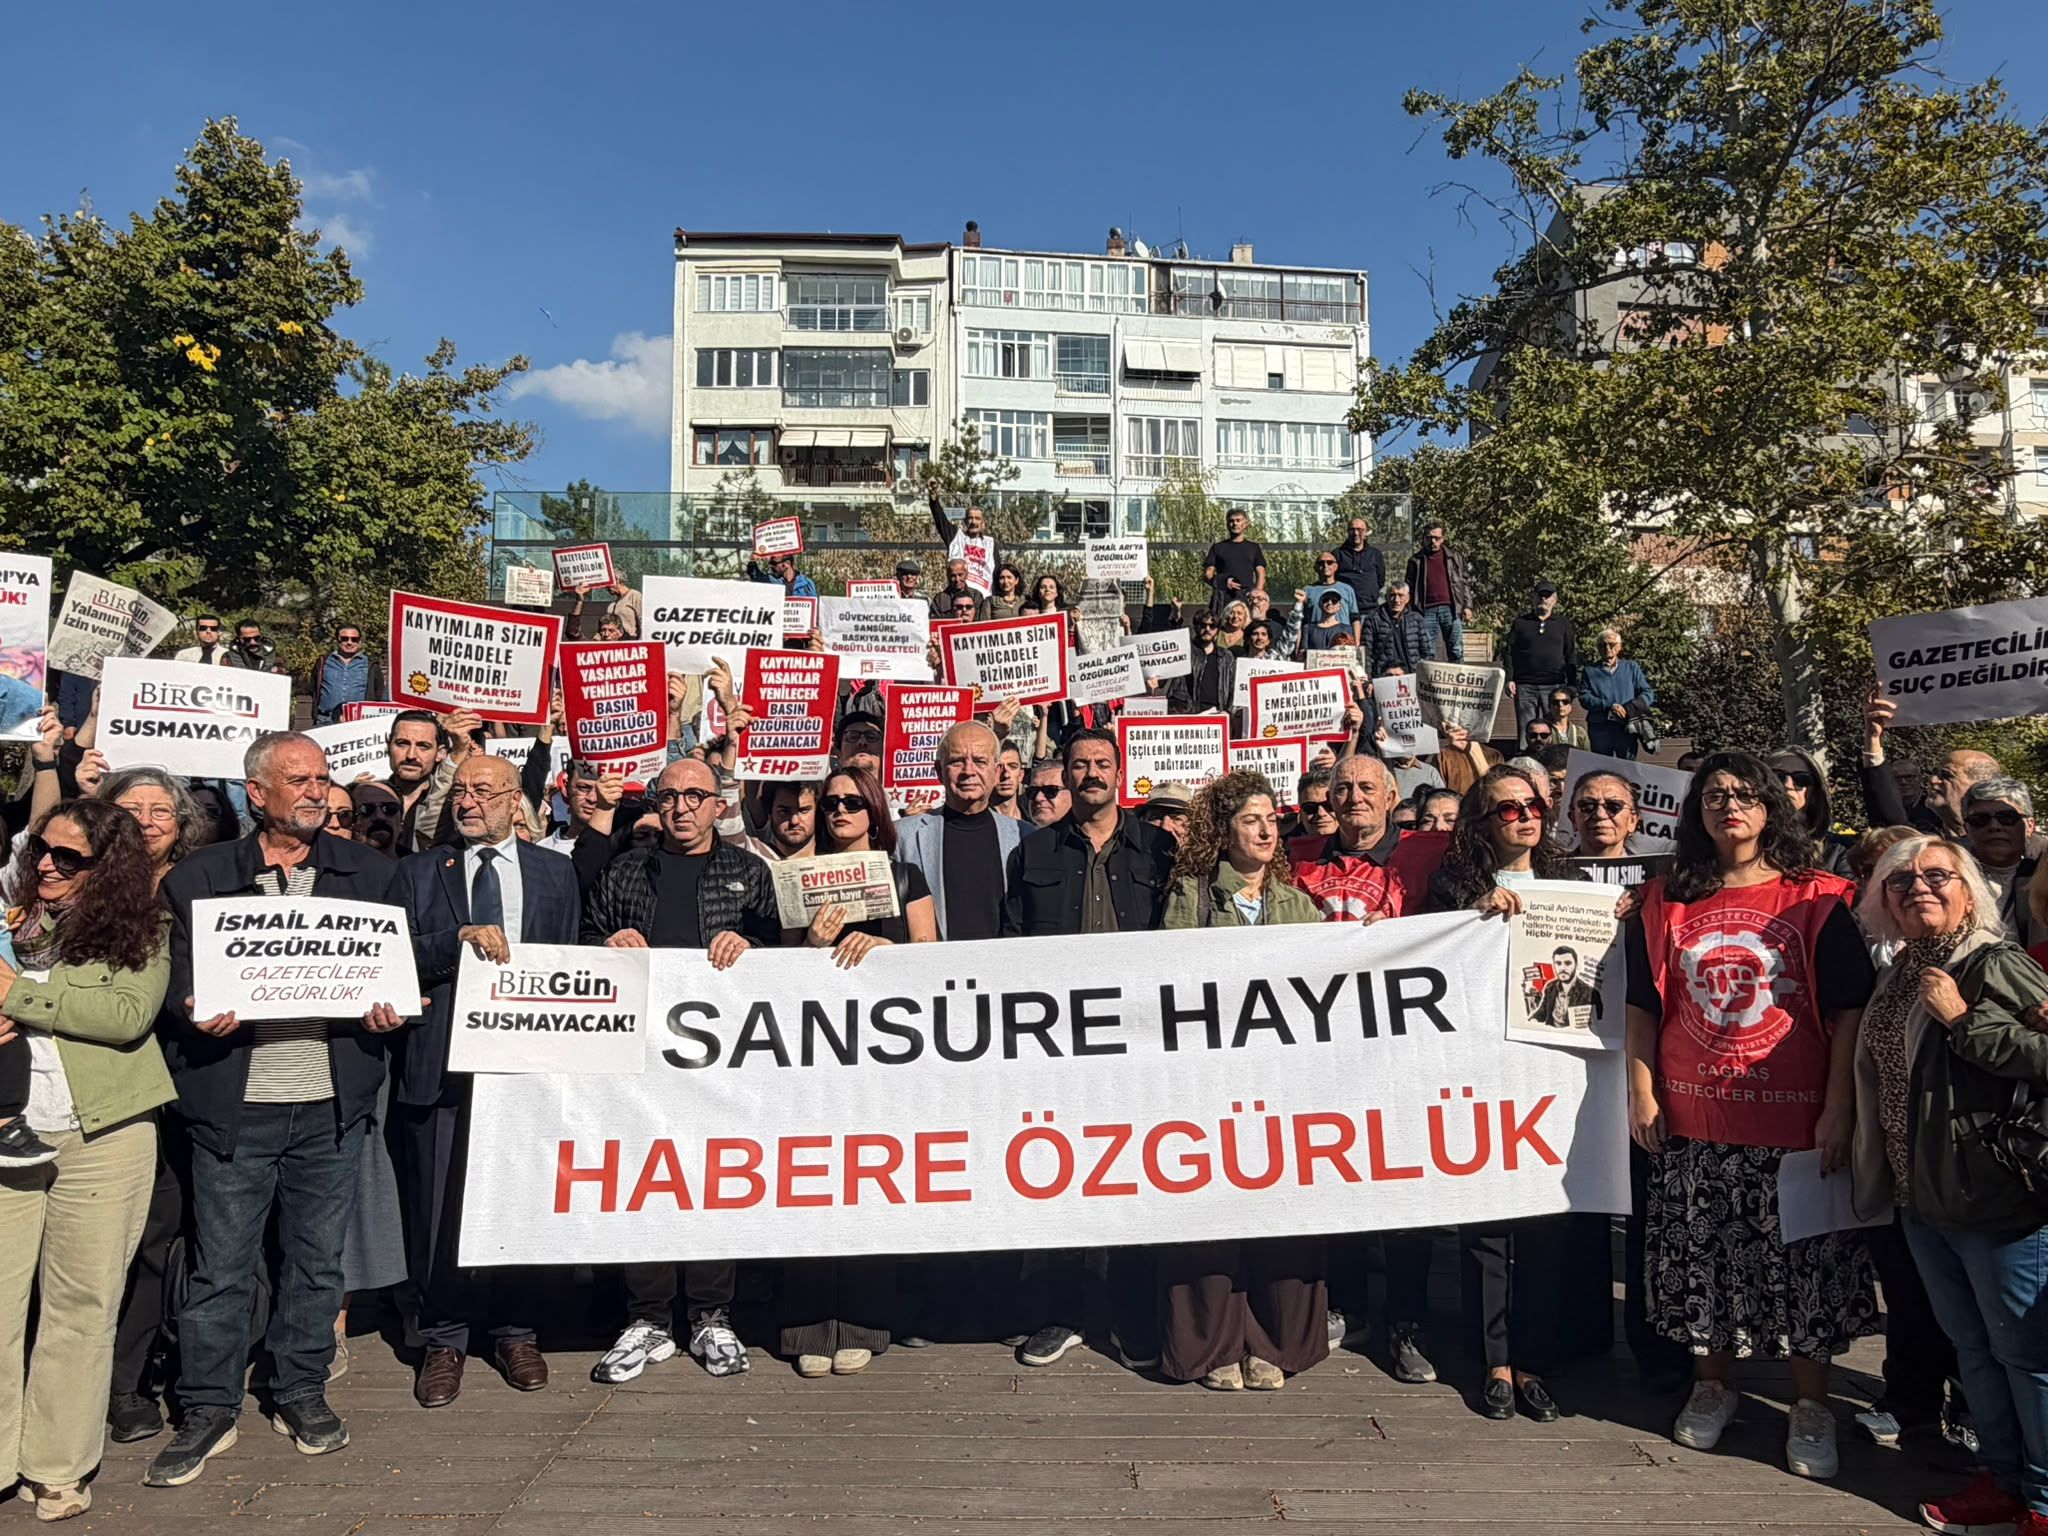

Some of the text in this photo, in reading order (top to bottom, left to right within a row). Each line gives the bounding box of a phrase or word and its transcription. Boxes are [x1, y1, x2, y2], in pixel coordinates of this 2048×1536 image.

[654, 606, 776, 626] GAZETECİLİK
[405, 610, 543, 648] KAYYIMLAR SİZİN
[854, 624, 898, 633] SANSÜRE,
[651, 629, 773, 648] SUÇ DEĞİLDİR!
[832, 642, 873, 652] ÖRGÜTLÜ
[842, 634, 909, 644] BASKIYA KARŞI
[954, 625, 1056, 652] KAYYIMLAR SİZİN
[429, 637, 513, 666] MÜCADELE
[576, 646, 648, 667] KAYYIMLAR
[975, 646, 1039, 667] MÜCADELE
[759, 656, 824, 670] KAYYIMLAR
[430, 658, 508, 688] BİZİMDİR!
[580, 663, 646, 683] YASAKLAR
[760, 671, 820, 685] YASAKLAR
[980, 663, 1038, 683] BİZİMDİR!
[438, 680, 522, 699] EMEK PARTİSİ
[581, 679, 648, 700] YENİLECEK
[759, 686, 819, 701] YENİLECEK
[1281, 679, 1319, 694] HALK TV
[1888, 675, 1935, 696] SUÇ
[595, 699, 635, 716] BASIN
[901, 691, 960, 705] KAYYIMLAR
[1265, 690, 1338, 711] EMEKÇİLERİNİN
[1380, 698, 1403, 709] HALK
[770, 703, 805, 716] BASIN
[902, 706, 957, 719] YASAKLAR
[1272, 707, 1332, 723] YANINDAYIZ!
[109, 719, 269, 742] SUSMAYACAK
[579, 712, 655, 736] ÖZGÜRLÜĞÜ
[751, 716, 822, 732] ÖZGÜRLÜĞÜ
[1391, 721, 1424, 734] ÇEKİN
[581, 731, 656, 752] KAZANACAK
[750, 735, 820, 749] KAZANACAK
[895, 749, 936, 764] ÖZGÜRL
[1237, 747, 1278, 761] HALK TV
[759, 759, 800, 775] EHP
[895, 767, 936, 780] KAZANA
[801, 861, 867, 888] evrensel
[1607, 865, 1646, 885] OLSUN:
[840, 889, 862, 901] hayır
[215, 910, 399, 935] İSMAİL ARI'YA
[225, 937, 382, 958] ÖZGÜRLÜK!
[240, 963, 383, 980] GAZETECİLERE
[251, 984, 363, 1001] ÖZGÜRLÜK!
[466, 1011, 636, 1032] SUSMAYACAK!
[663, 966, 1457, 1069] SANSÜRE HAYIR
[554, 1087, 1562, 1214] HABERE ÖZGÜRLÜK
